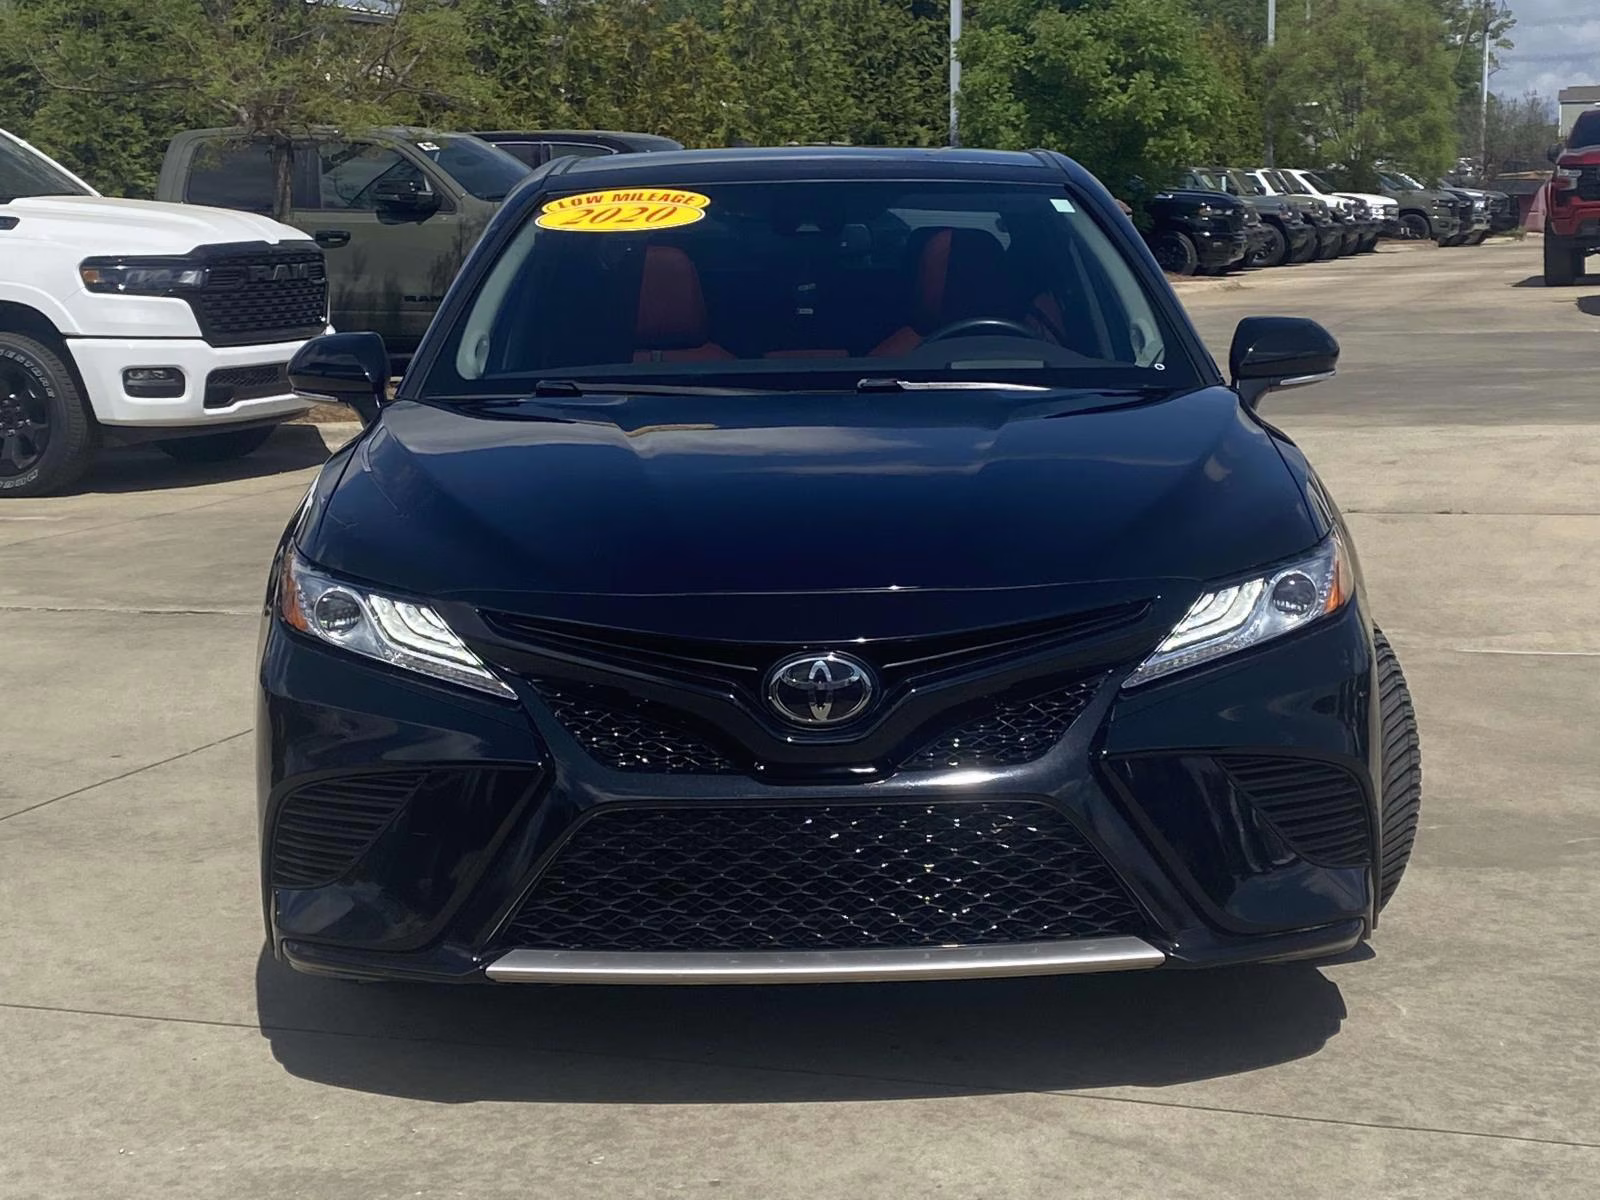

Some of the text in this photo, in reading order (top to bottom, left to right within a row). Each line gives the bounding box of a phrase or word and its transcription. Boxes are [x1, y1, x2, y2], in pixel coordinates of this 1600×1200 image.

[558, 192, 696, 209] LOW MILEAGE
[559, 206, 678, 226] 2020
